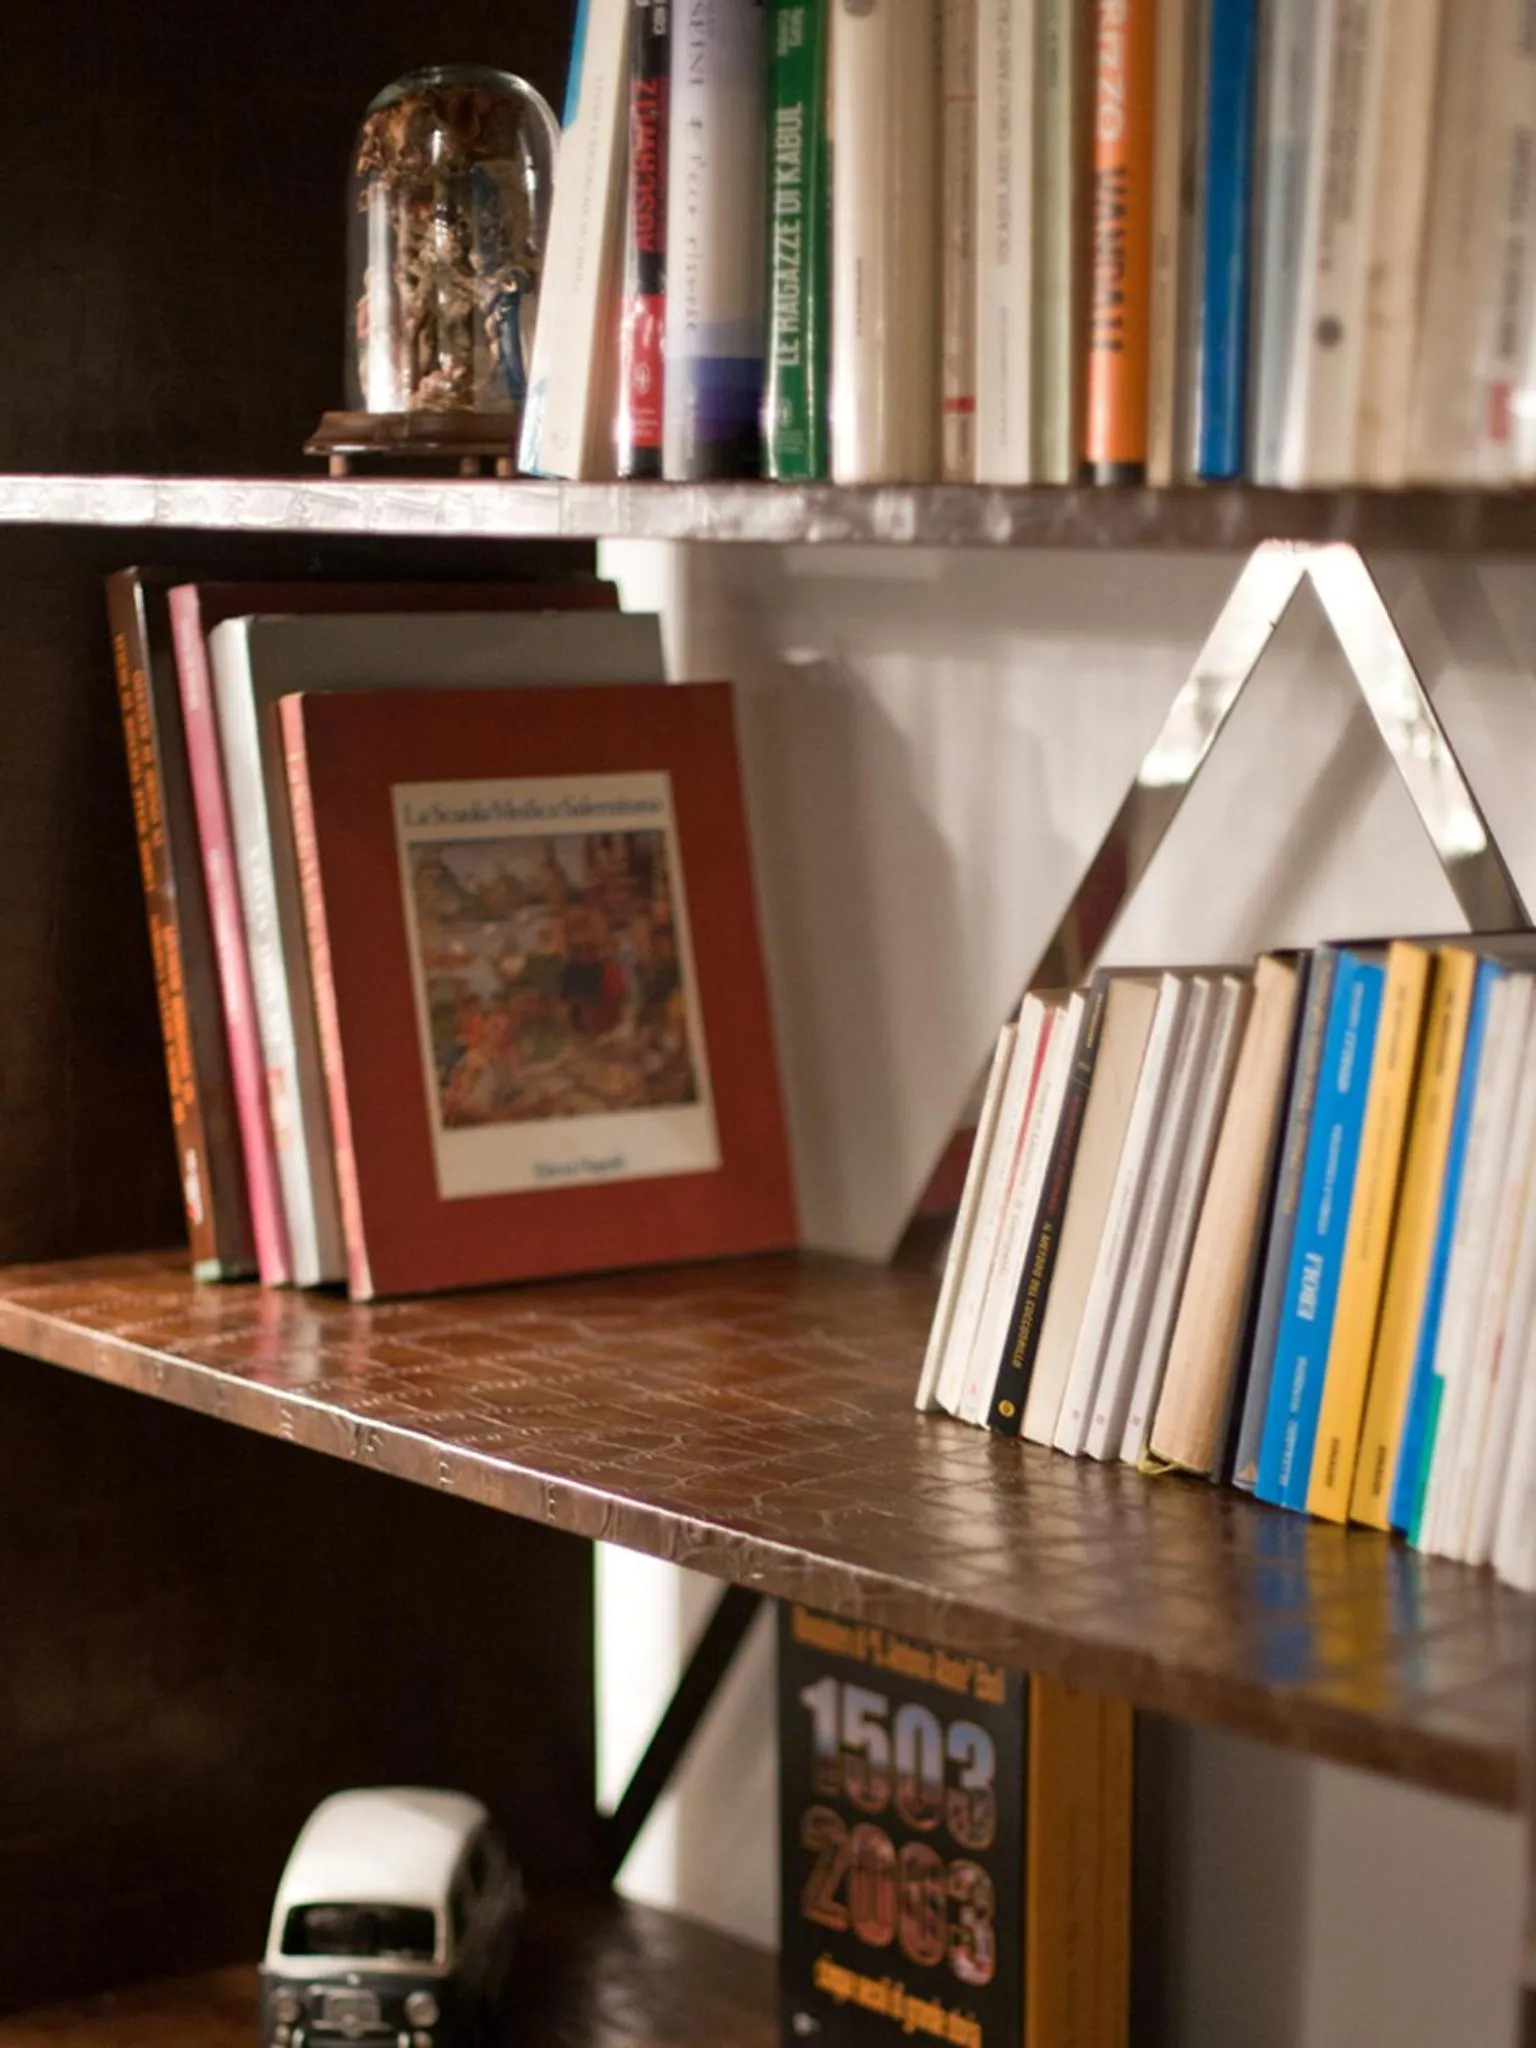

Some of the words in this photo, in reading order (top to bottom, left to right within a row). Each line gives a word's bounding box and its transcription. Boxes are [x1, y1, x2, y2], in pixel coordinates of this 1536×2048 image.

[632, 78, 660, 251] AUSCHWITZ
[776, 103, 802, 185] KABUL
[777, 187, 801, 215] DI
[777, 219, 801, 333] RAGAZZE
[777, 334, 800, 367] LE
[1011, 1300, 1037, 1370] COCCODRILLO
[799, 1674, 997, 1851] 1503
[800, 1805, 997, 1988] 2003
